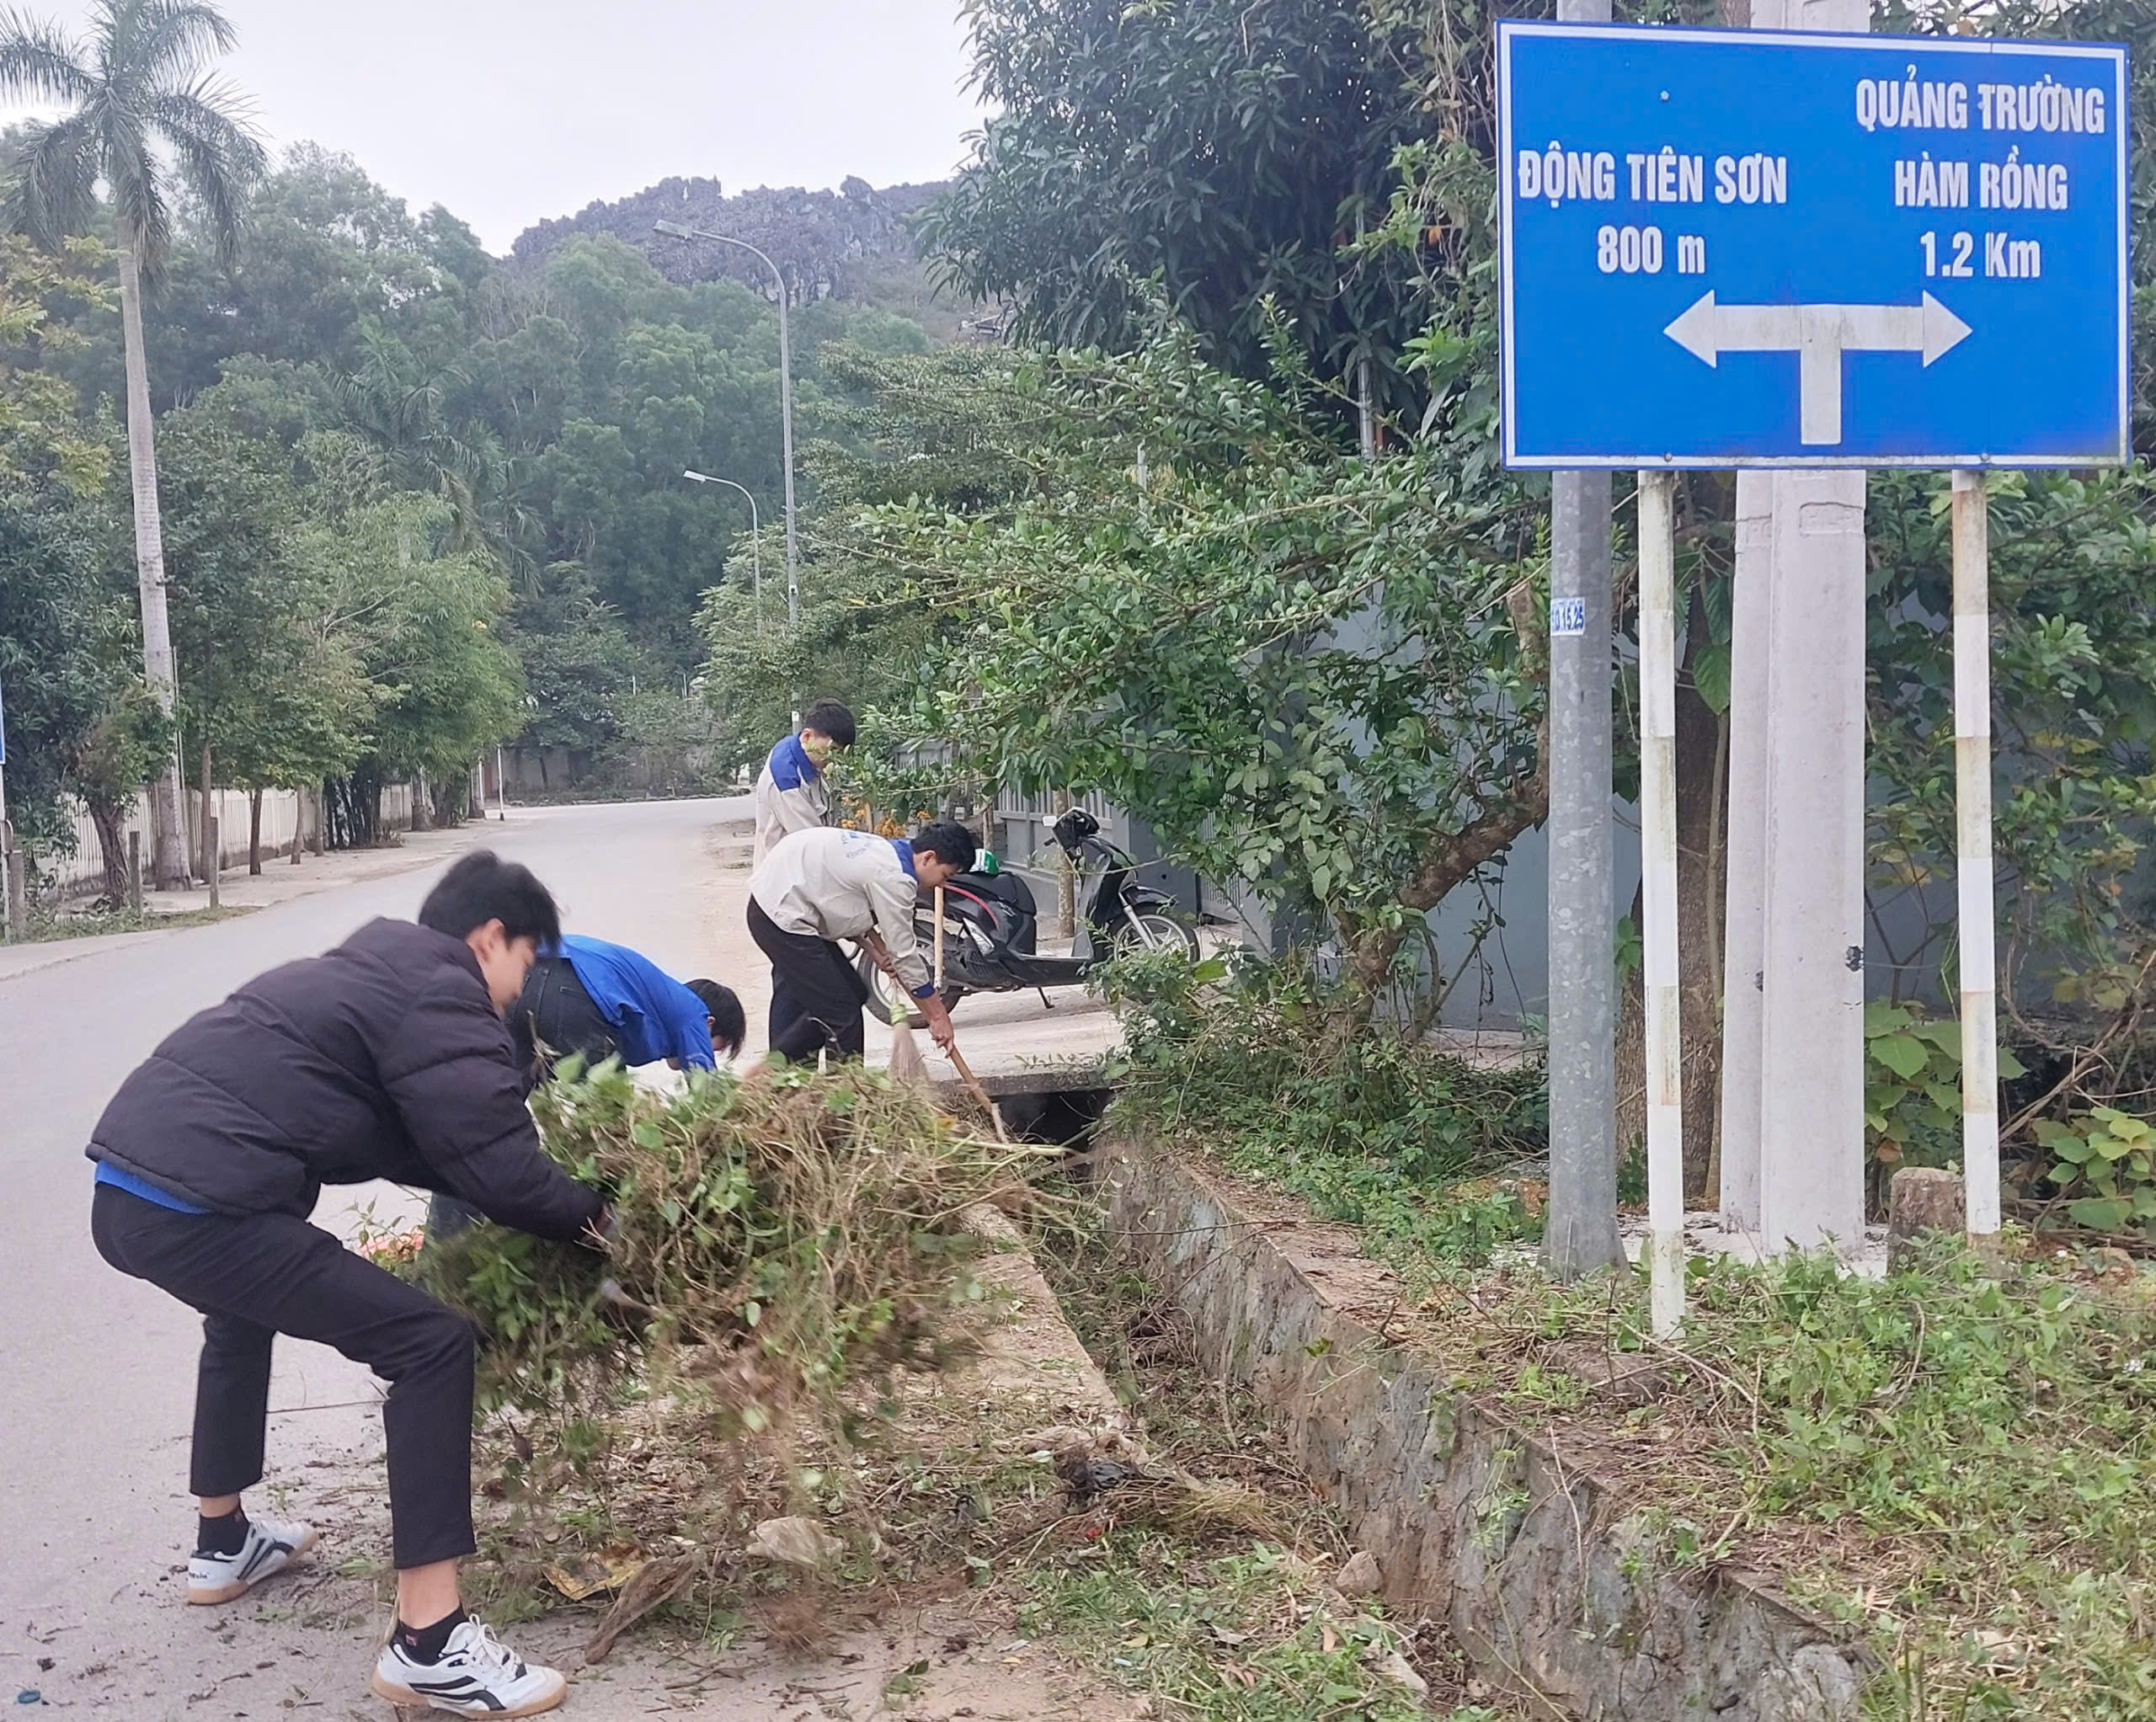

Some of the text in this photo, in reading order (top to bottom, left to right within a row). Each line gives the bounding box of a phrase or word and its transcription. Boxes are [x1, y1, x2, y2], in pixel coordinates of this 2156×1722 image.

[1855, 63, 2105, 134] QUẢNG TRƯỜNG
[1518, 140, 1787, 208] ĐỘNG TIÊN SƠN
[1895, 144, 2068, 211] HÀM RỒNG
[1597, 225, 1705, 275] 800 m
[1920, 231, 2041, 279] 1.2 Km
